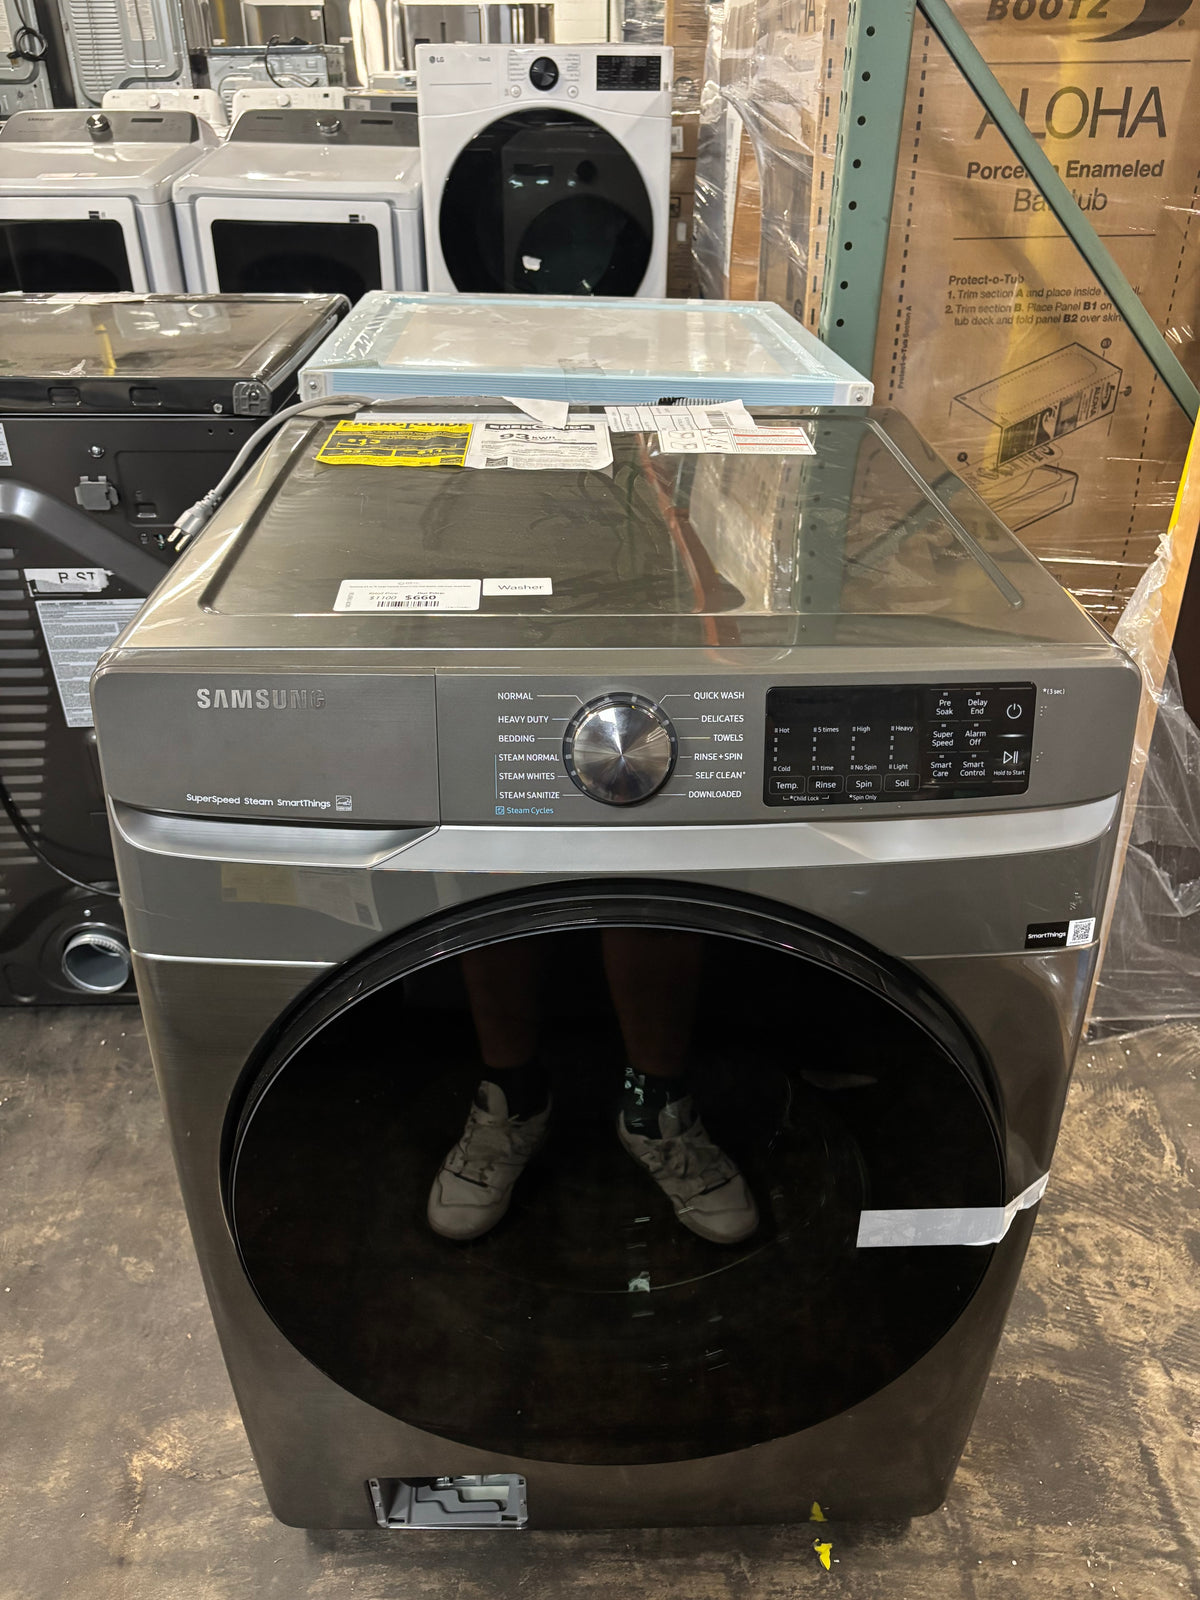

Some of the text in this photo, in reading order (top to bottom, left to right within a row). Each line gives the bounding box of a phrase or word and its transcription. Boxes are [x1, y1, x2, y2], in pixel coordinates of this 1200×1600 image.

[1066, 160, 1164, 178] Enameled
[948, 273, 1024, 286] Protect-o-Tub
[948, 290, 955, 299] 1.
[958, 290, 978, 299] Trim
[980, 290, 1013, 298] section
[1016, 288, 1023, 297] A
[1046, 288, 1072, 298] place
[1074, 286, 1102, 296] inside
[945, 305, 953, 314] 2.
[956, 304, 976, 314] Trim
[978, 304, 1012, 313] section
[1014, 303, 1024, 312] B.
[1027, 302, 1052, 312] Place
[1055, 302, 1080, 311] Panel
[1083, 302, 1098, 310] B1
[954, 317, 969, 326] tub
[971, 316, 993, 325] deck
[1016, 314, 1034, 324] fold
[1036, 314, 1061, 325] panel
[1063, 314, 1078, 323] B2
[196, 688, 326, 710] SAMSUNG
[694, 691, 744, 700] QUICK WASH
[968, 699, 988, 707] Delay
[856, 726, 870, 734] High
[933, 731, 953, 739] Super
[932, 739, 953, 747] Speed
[776, 781, 798, 790] Temp.
[855, 780, 872, 789] Spin
[895, 779, 910, 787] Soil
[186, 793, 240, 805] SuperSpeed
[244, 797, 273, 806] Steam
[277, 798, 331, 810] SmartThings
[531, 807, 554, 815] Cycles
